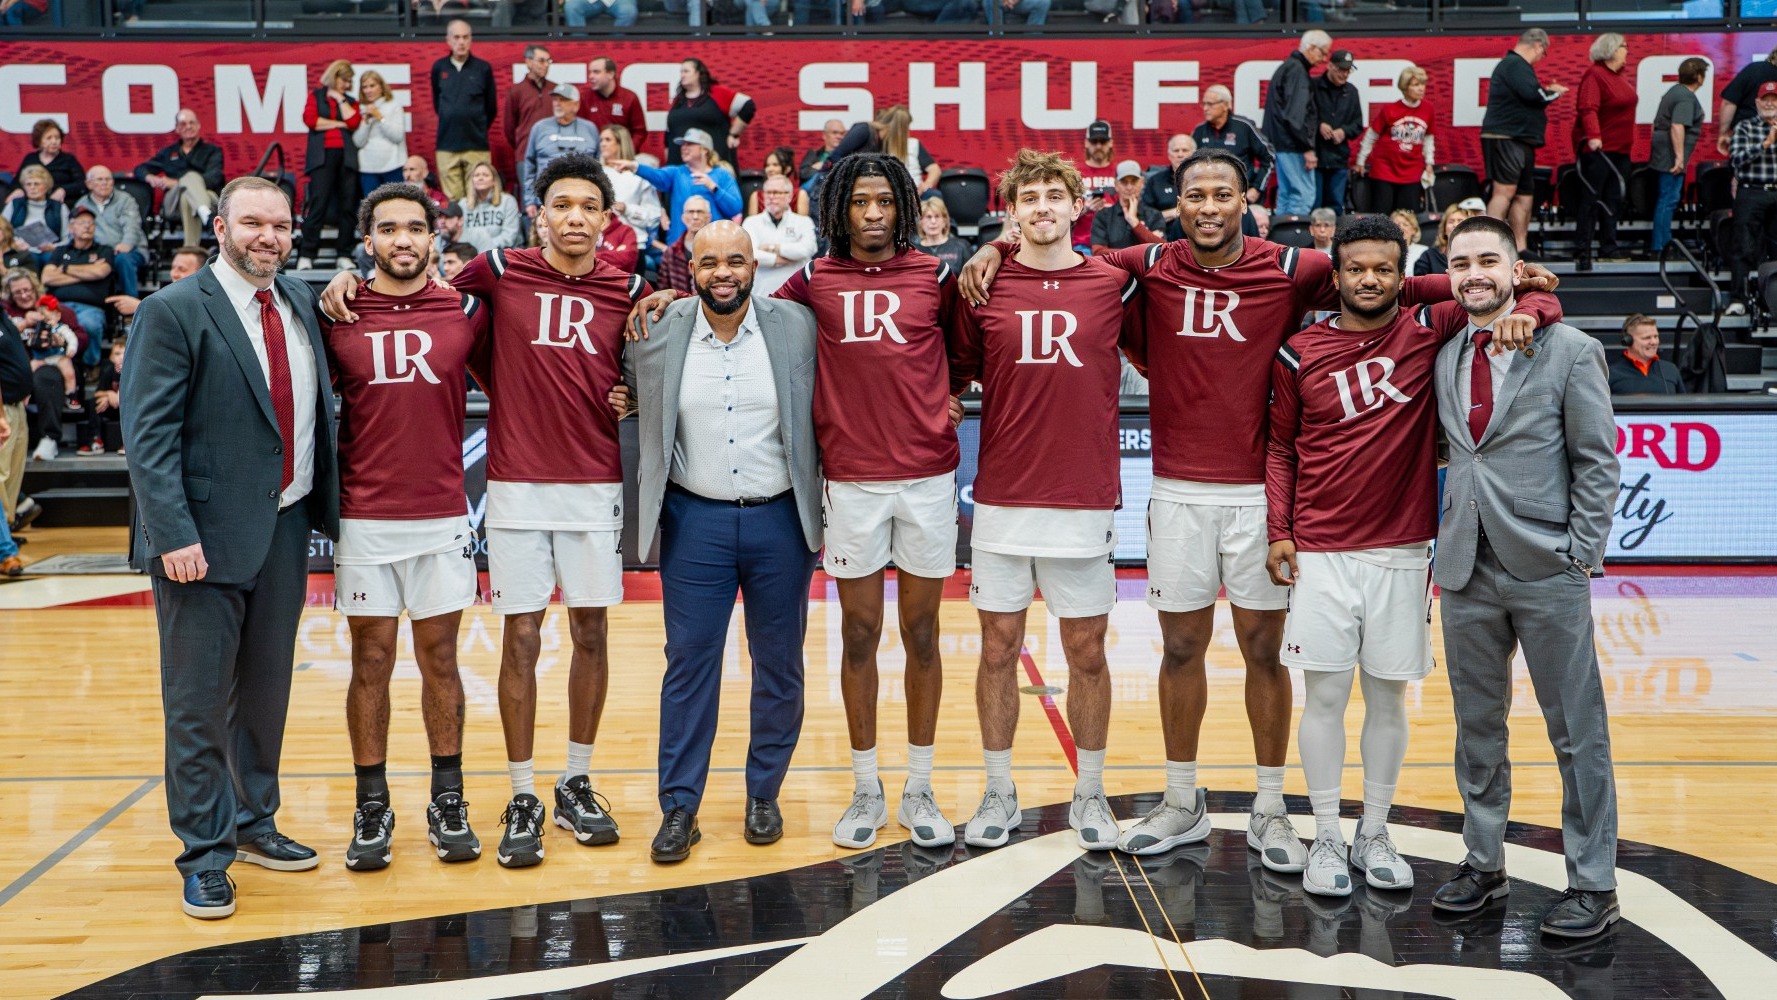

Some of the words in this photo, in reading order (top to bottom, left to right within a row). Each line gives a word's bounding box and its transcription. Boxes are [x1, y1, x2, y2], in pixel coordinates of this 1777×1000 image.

[466, 210, 504, 227] PARIS
[531, 293, 598, 355] LR
[838, 290, 908, 344] LR
[1015, 310, 1084, 368] LR
[1176, 286, 1247, 342] LR
[364, 329, 442, 385] LR
[1329, 356, 1413, 423] LR
[1613, 472, 1674, 551] ty
